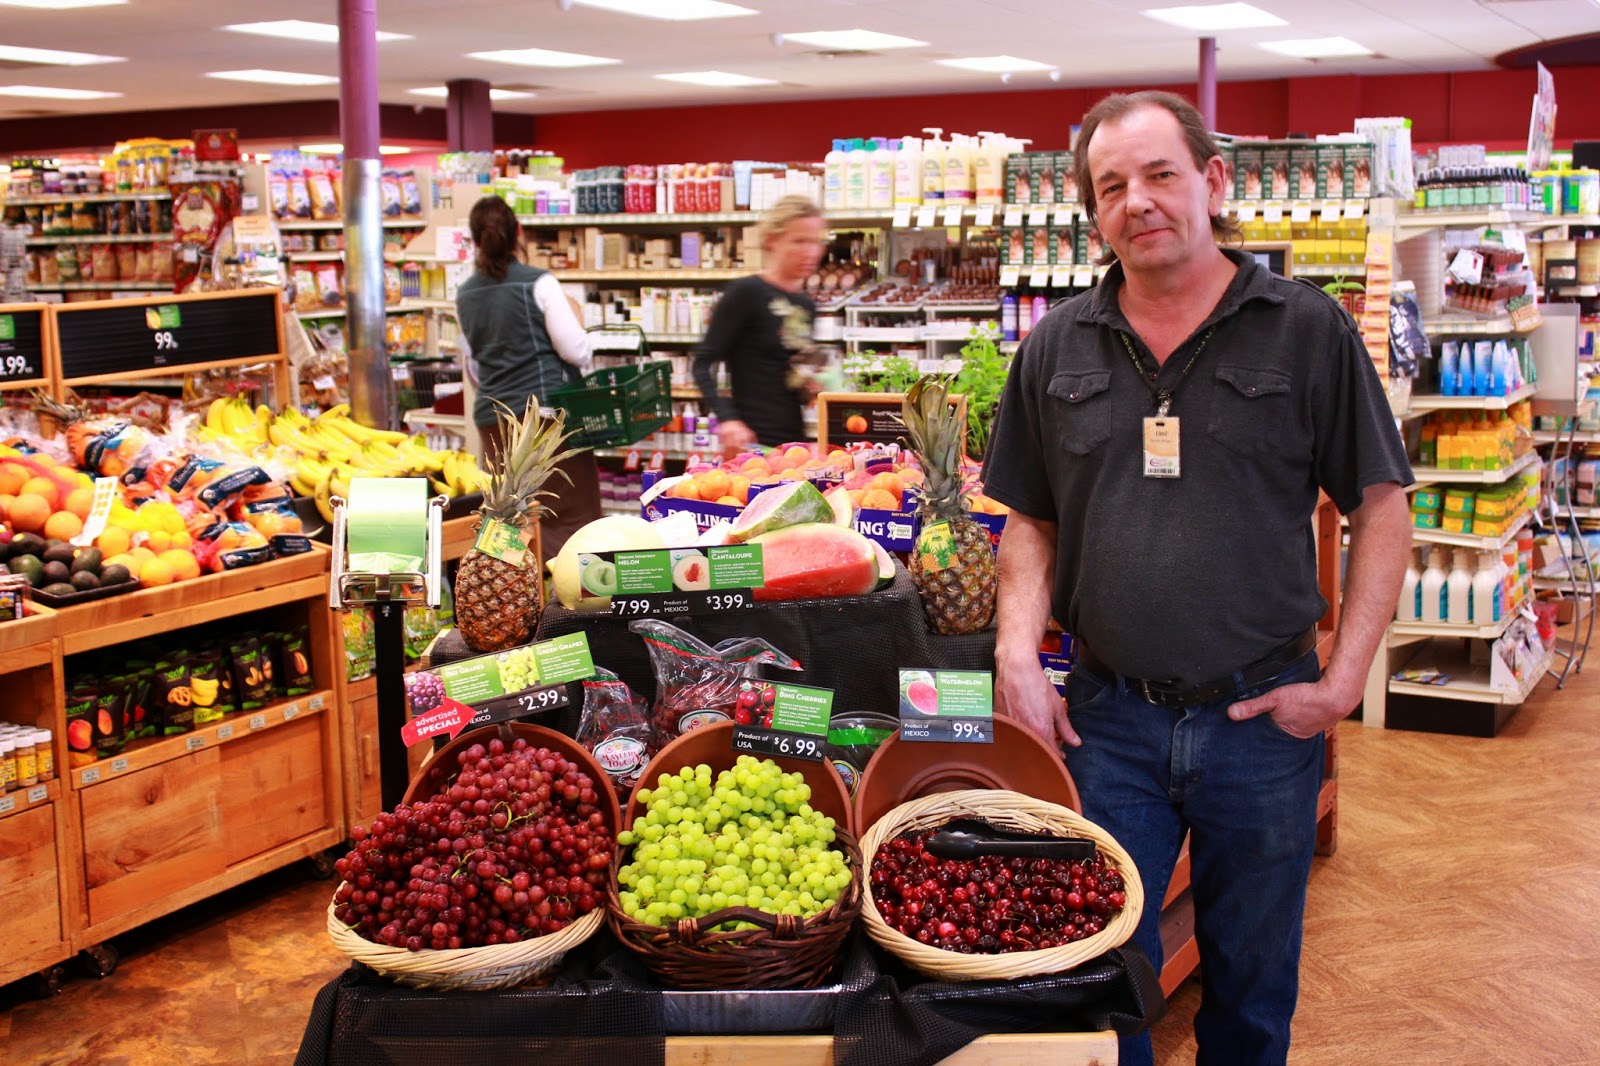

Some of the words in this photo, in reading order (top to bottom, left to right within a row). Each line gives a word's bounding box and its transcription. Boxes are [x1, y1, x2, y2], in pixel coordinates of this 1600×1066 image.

[154, 331, 172, 350] 99
[611, 600, 650, 616] $7.99
[706, 594, 744, 611] $3.99
[537, 647, 558, 656] GREEN
[559, 641, 584, 650] GRAPES
[460, 664, 485, 674] GRAPES
[940, 678, 983, 686] WATERMELON
[518, 690, 559, 711] $2.99
[779, 691, 795, 699] BING
[796, 693, 827, 704] CHERRIES
[415, 708, 458, 726] advertised
[416, 716, 461, 736] SPECIAL!
[738, 731, 761, 741] Product
[737, 740, 752, 749] USA
[774, 737, 816, 756] $6.99
